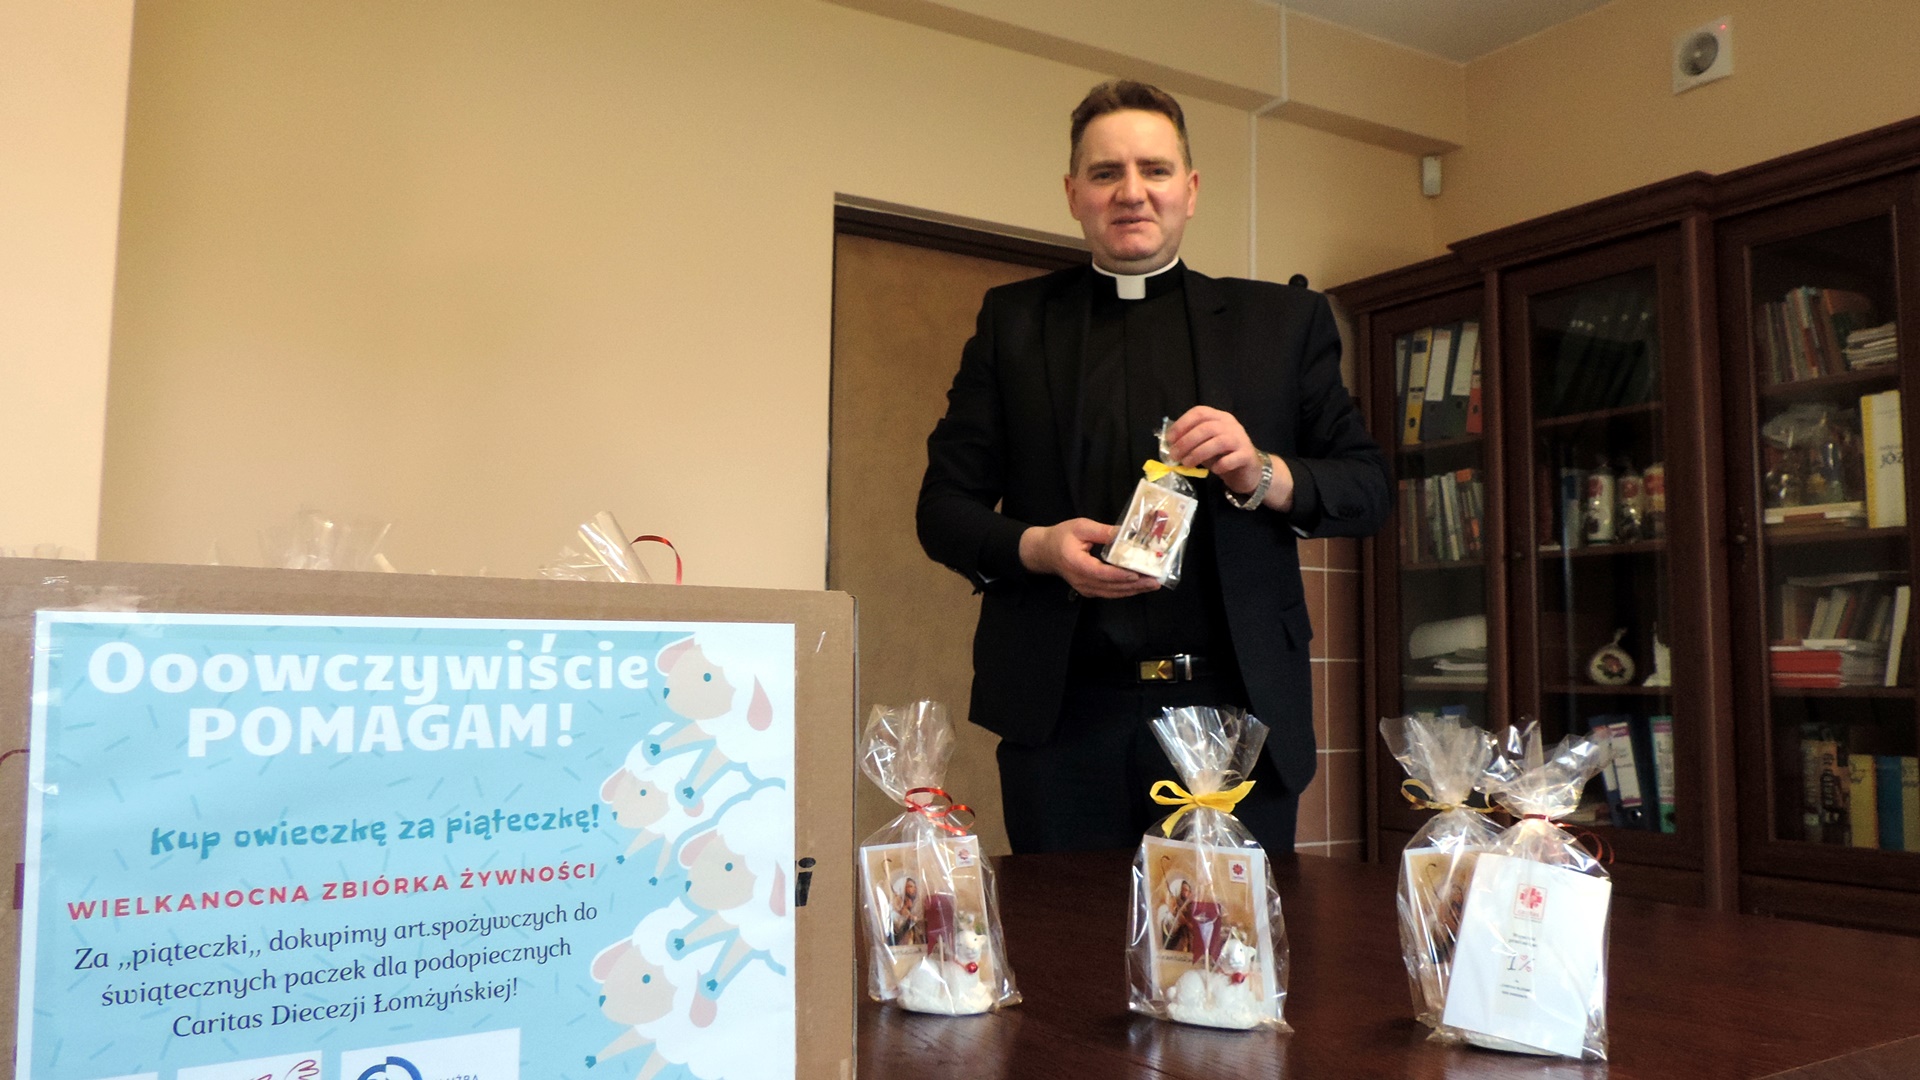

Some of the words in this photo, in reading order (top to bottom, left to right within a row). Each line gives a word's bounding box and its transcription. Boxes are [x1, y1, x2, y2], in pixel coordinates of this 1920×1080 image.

[88, 633, 650, 706] Ooowczywiście
[188, 703, 573, 757] POMAGAM!
[150, 827, 221, 860] Kup
[234, 818, 387, 848] owieczkę
[398, 817, 435, 840] za
[446, 803, 599, 844] piąteczkę!
[67, 885, 309, 920] WIELKANOCNA
[322, 874, 449, 901] ZBIÓRKA
[460, 861, 595, 889] ŻYWNOŚCI
[74, 947, 109, 970] Za
[269, 927, 387, 952] dokupimy
[393, 904, 567, 941] art.spożywczych
[574, 901, 598, 921] do
[101, 968, 277, 1007] świątecznych
[284, 959, 366, 994] paczek
[373, 955, 407, 978] dla
[414, 936, 572, 979] podopiecznych
[172, 1011, 263, 1038] Caritas
[271, 995, 365, 1026] Diecezji
[373, 977, 517, 1014] Łomżyńskiej!
